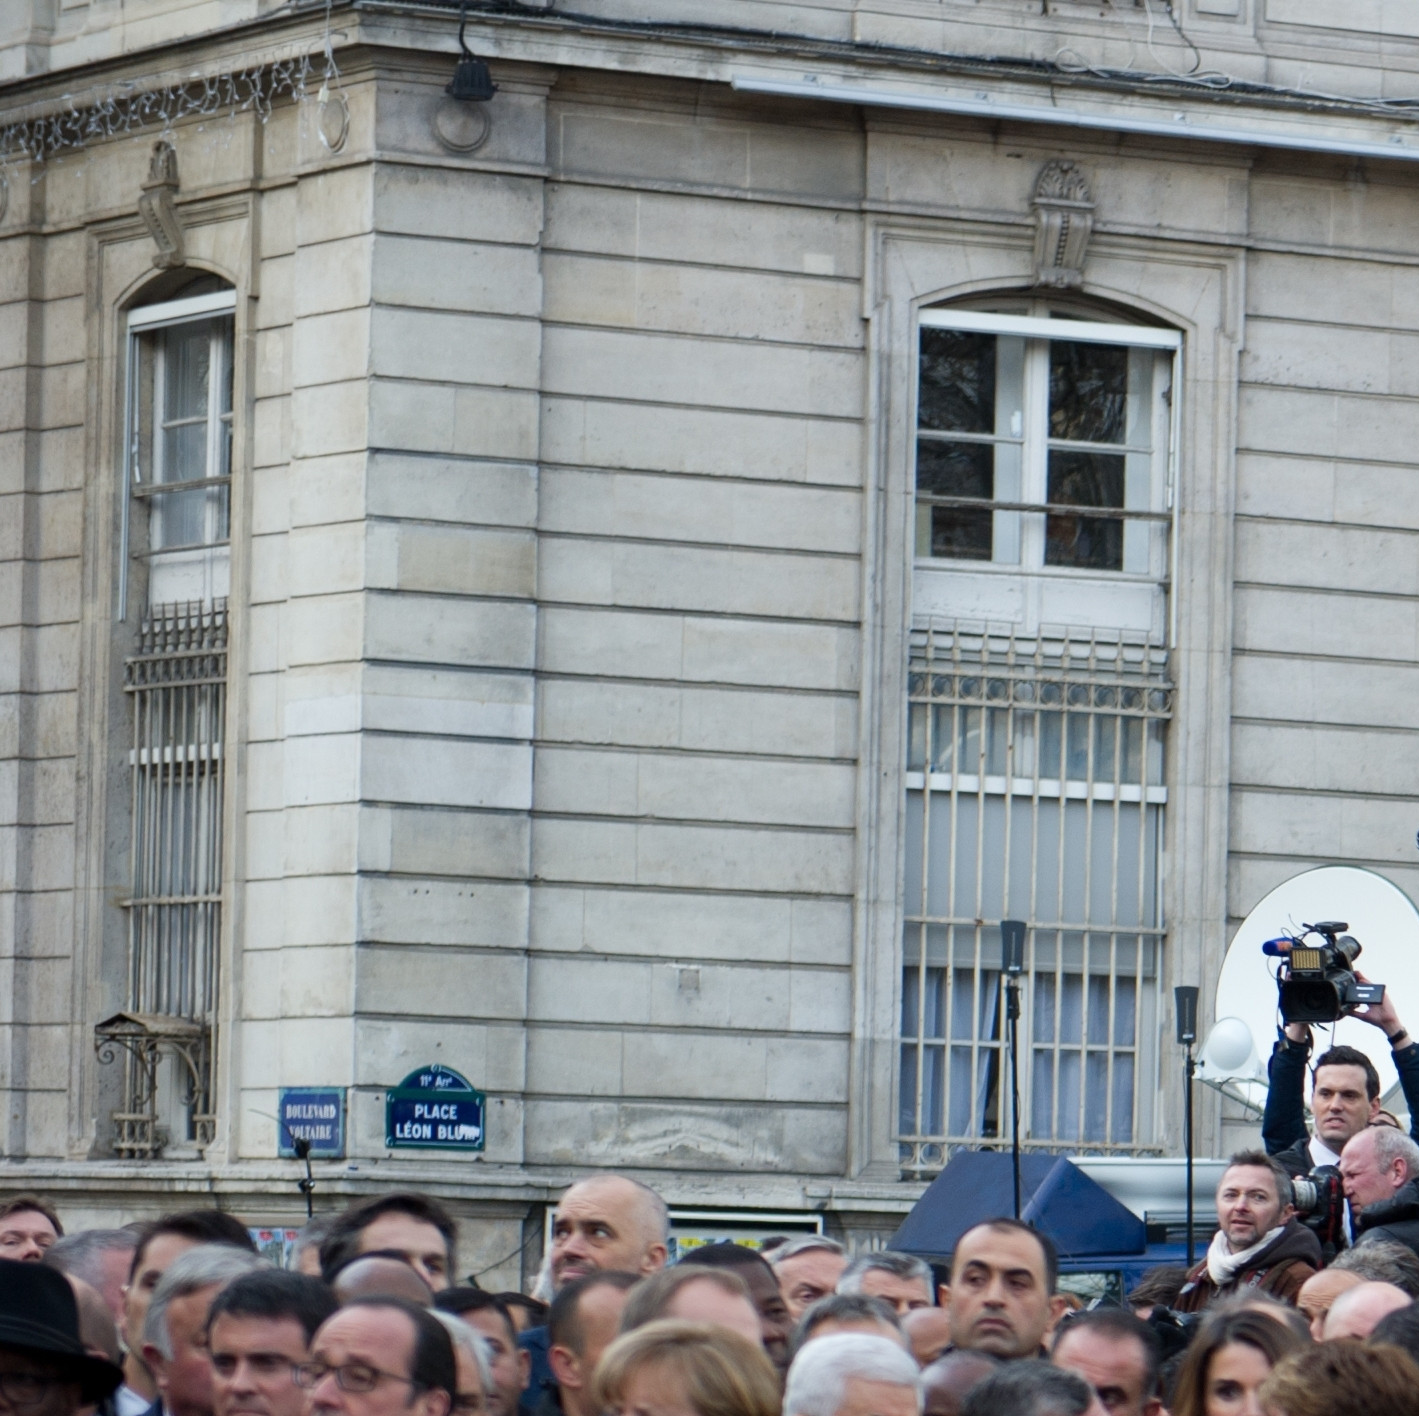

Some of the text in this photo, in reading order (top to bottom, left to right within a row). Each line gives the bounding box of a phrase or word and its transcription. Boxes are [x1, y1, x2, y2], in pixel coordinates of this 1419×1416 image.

[286, 1104, 337, 1119] BOULEVARD
[415, 1103, 458, 1120] PLACE
[289, 1125, 332, 1140] VOLTAIRE
[395, 1121, 432, 1139] LÉON
